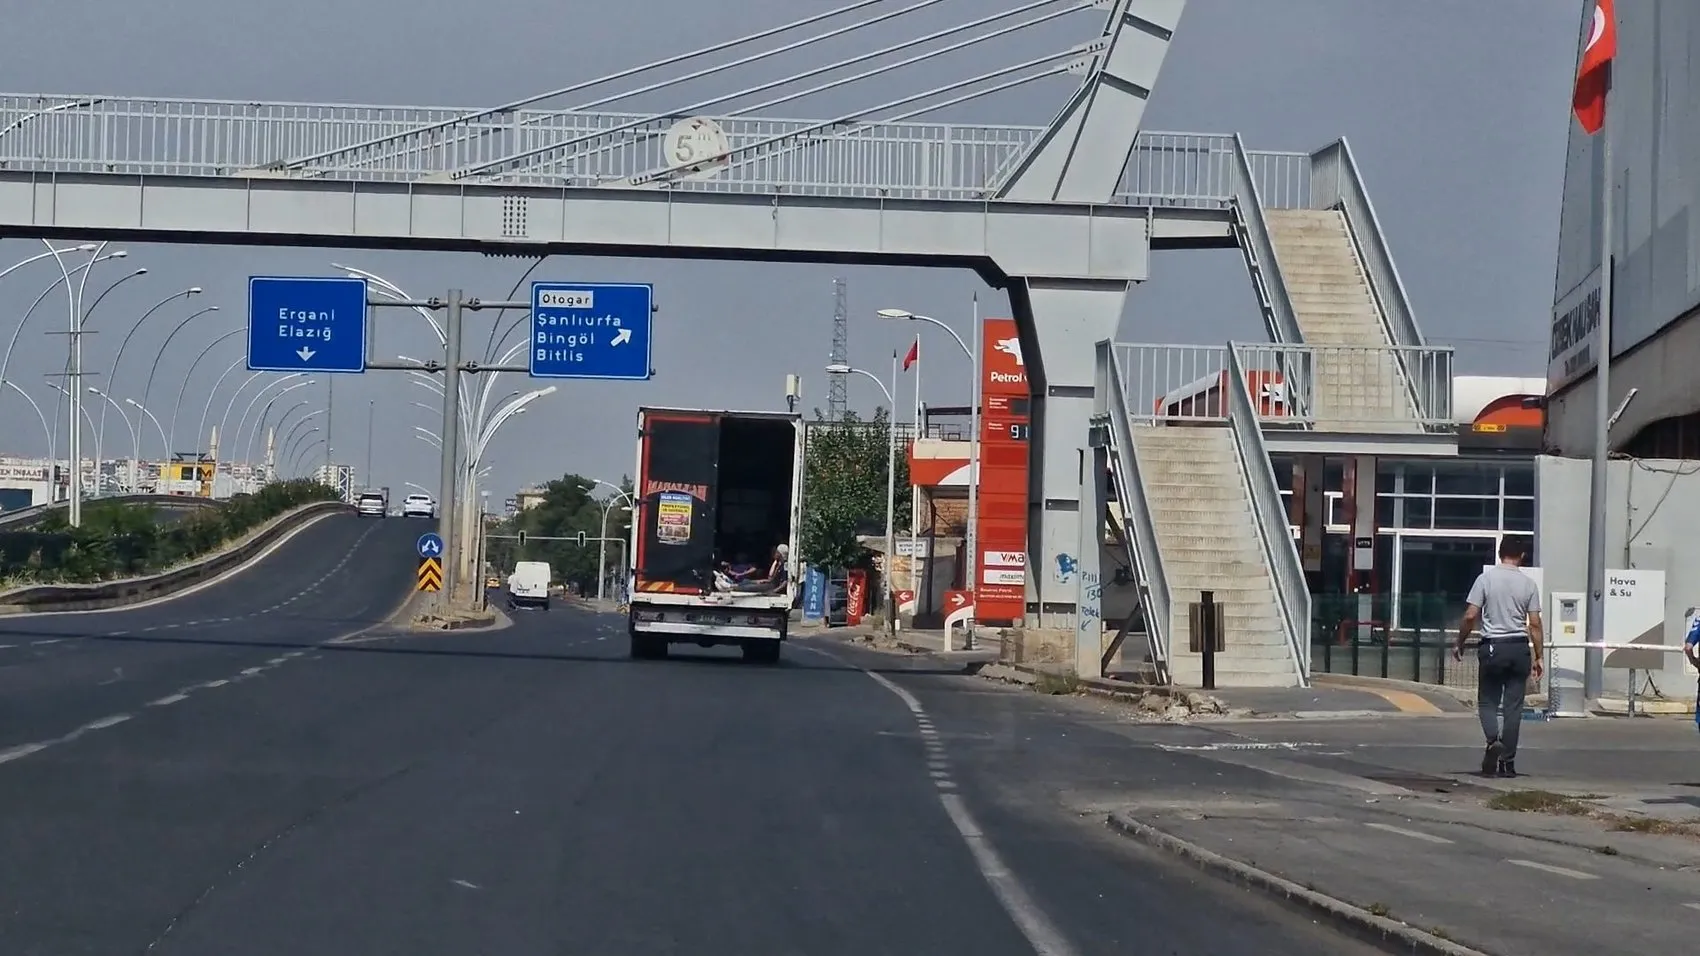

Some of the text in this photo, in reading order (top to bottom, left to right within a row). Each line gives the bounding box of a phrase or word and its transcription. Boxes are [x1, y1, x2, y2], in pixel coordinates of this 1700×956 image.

[676, 134, 694, 162] 5
[542, 293, 590, 307] Otogar
[279, 307, 335, 323] Ergani
[538, 312, 621, 327] Şanlıurfa
[279, 324, 331, 341] Elazığ
[537, 331, 594, 348] Bingöl
[536, 348, 584, 362] Bitlis
[990, 371, 1023, 382] Petrol
[1609, 576, 1636, 586] Hava
[1609, 587, 1632, 597] & Su
